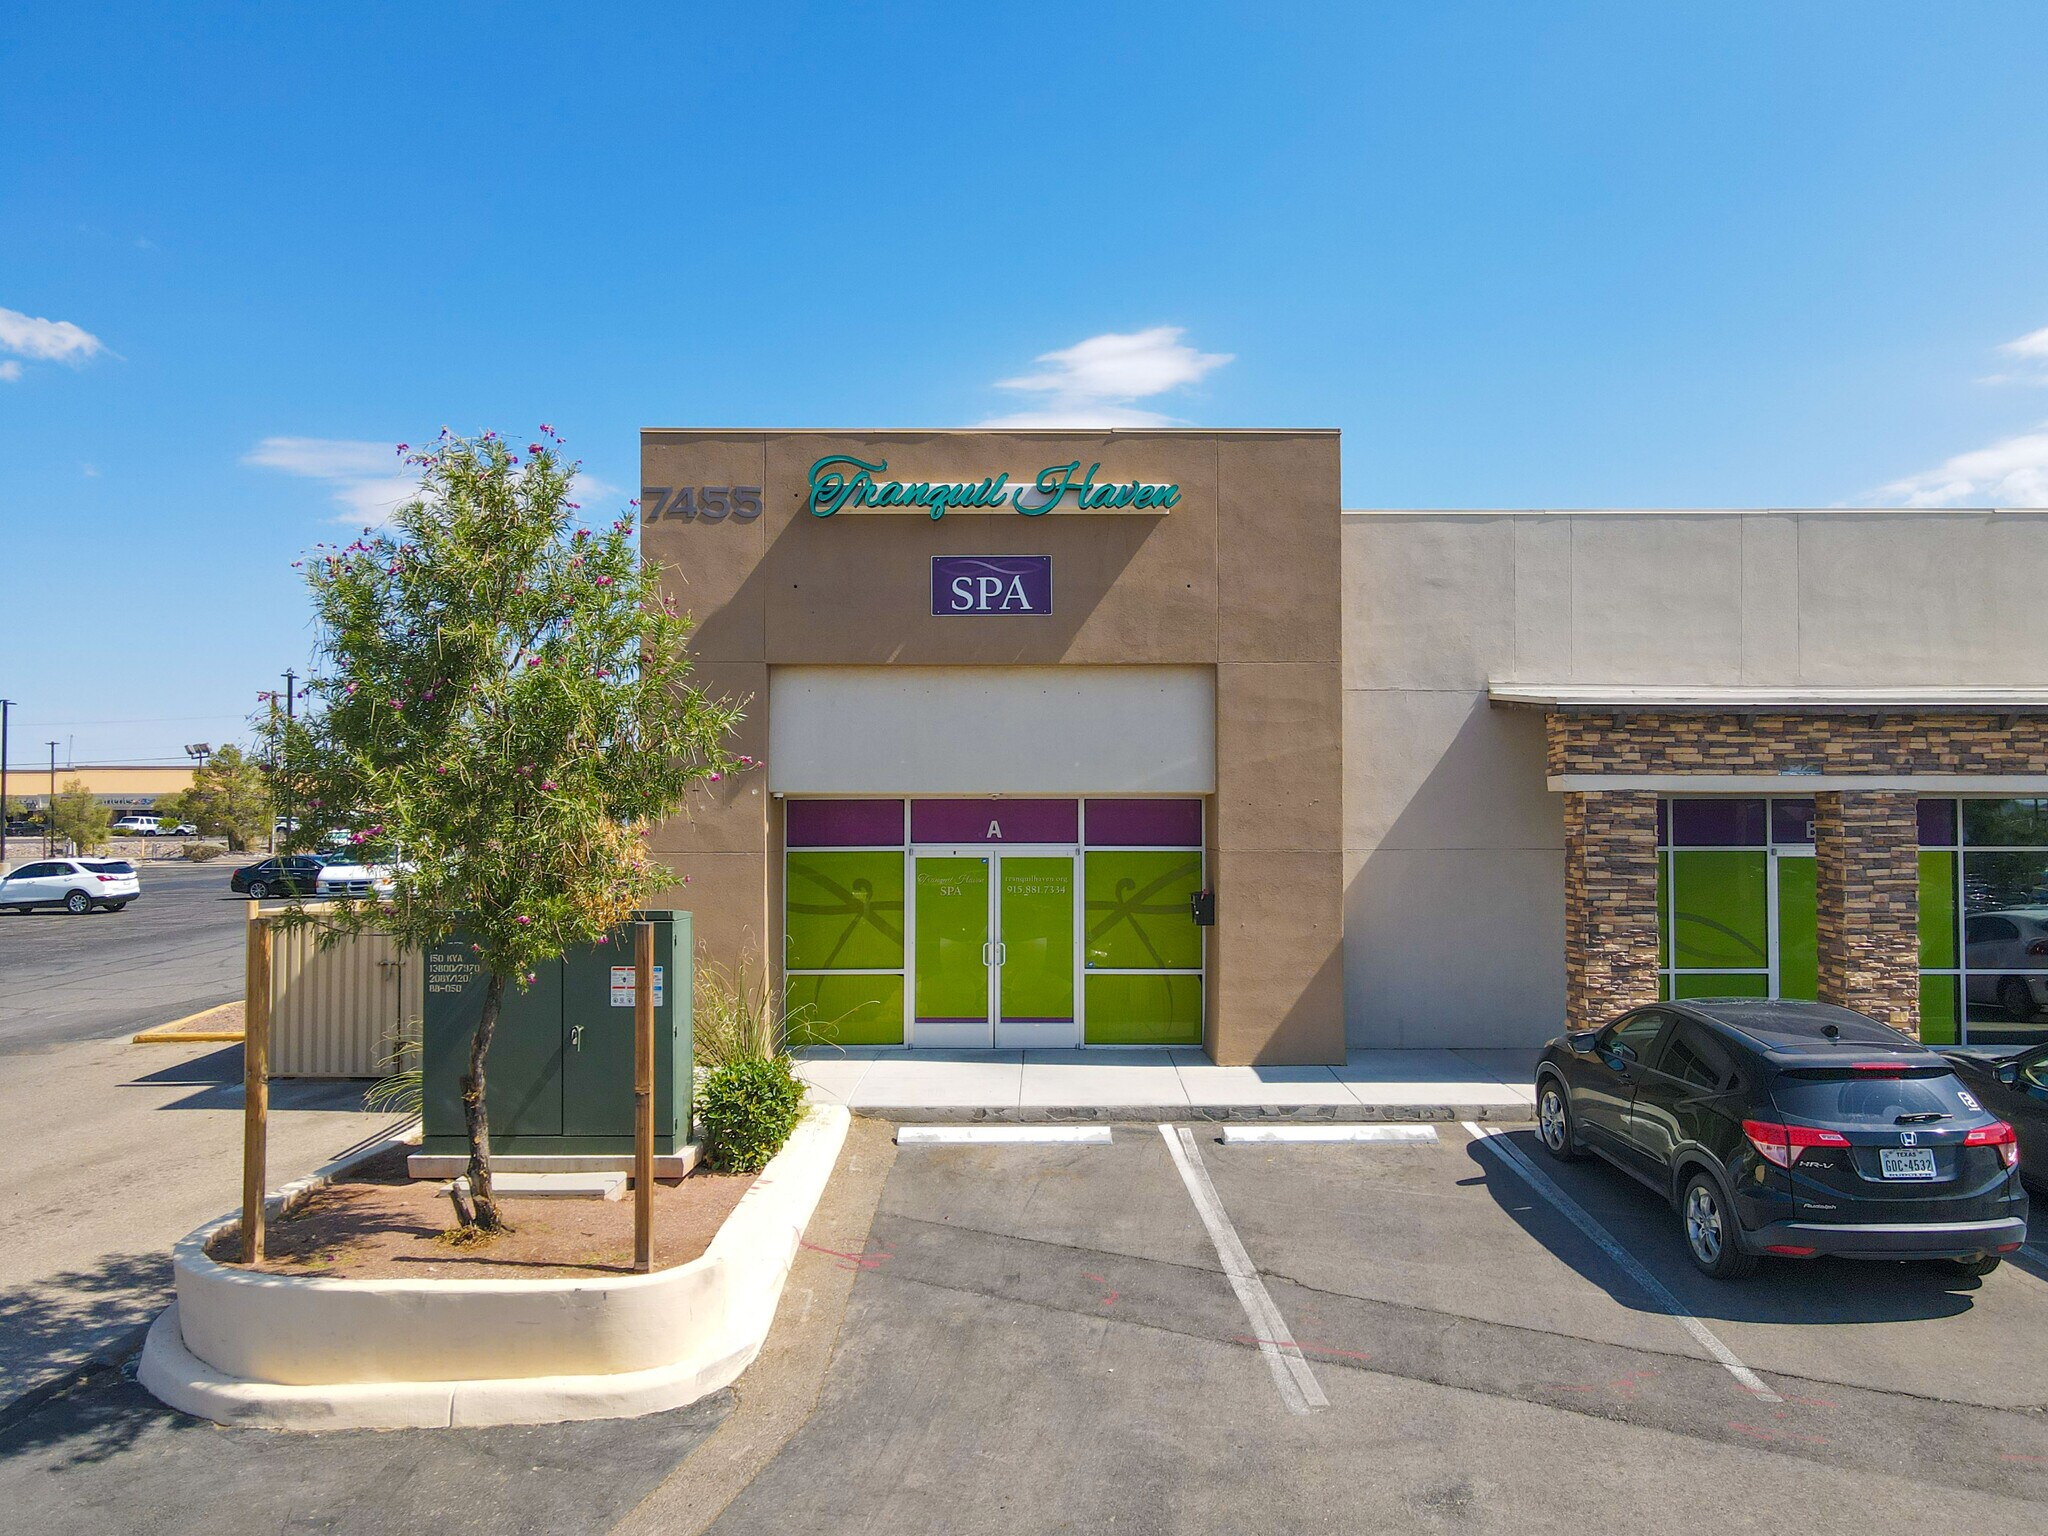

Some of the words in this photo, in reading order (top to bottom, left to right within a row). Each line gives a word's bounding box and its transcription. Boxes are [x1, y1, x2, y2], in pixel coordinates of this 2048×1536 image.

[807, 454, 1008, 520] Tranquil
[1012, 460, 1182, 516] Haven
[643, 486, 763, 518] 7455
[951, 576, 1033, 611] SPA
[986, 820, 1003, 839] A
[940, 886, 962, 896] SPA
[1799, 1160, 1834, 1169] HR-V
